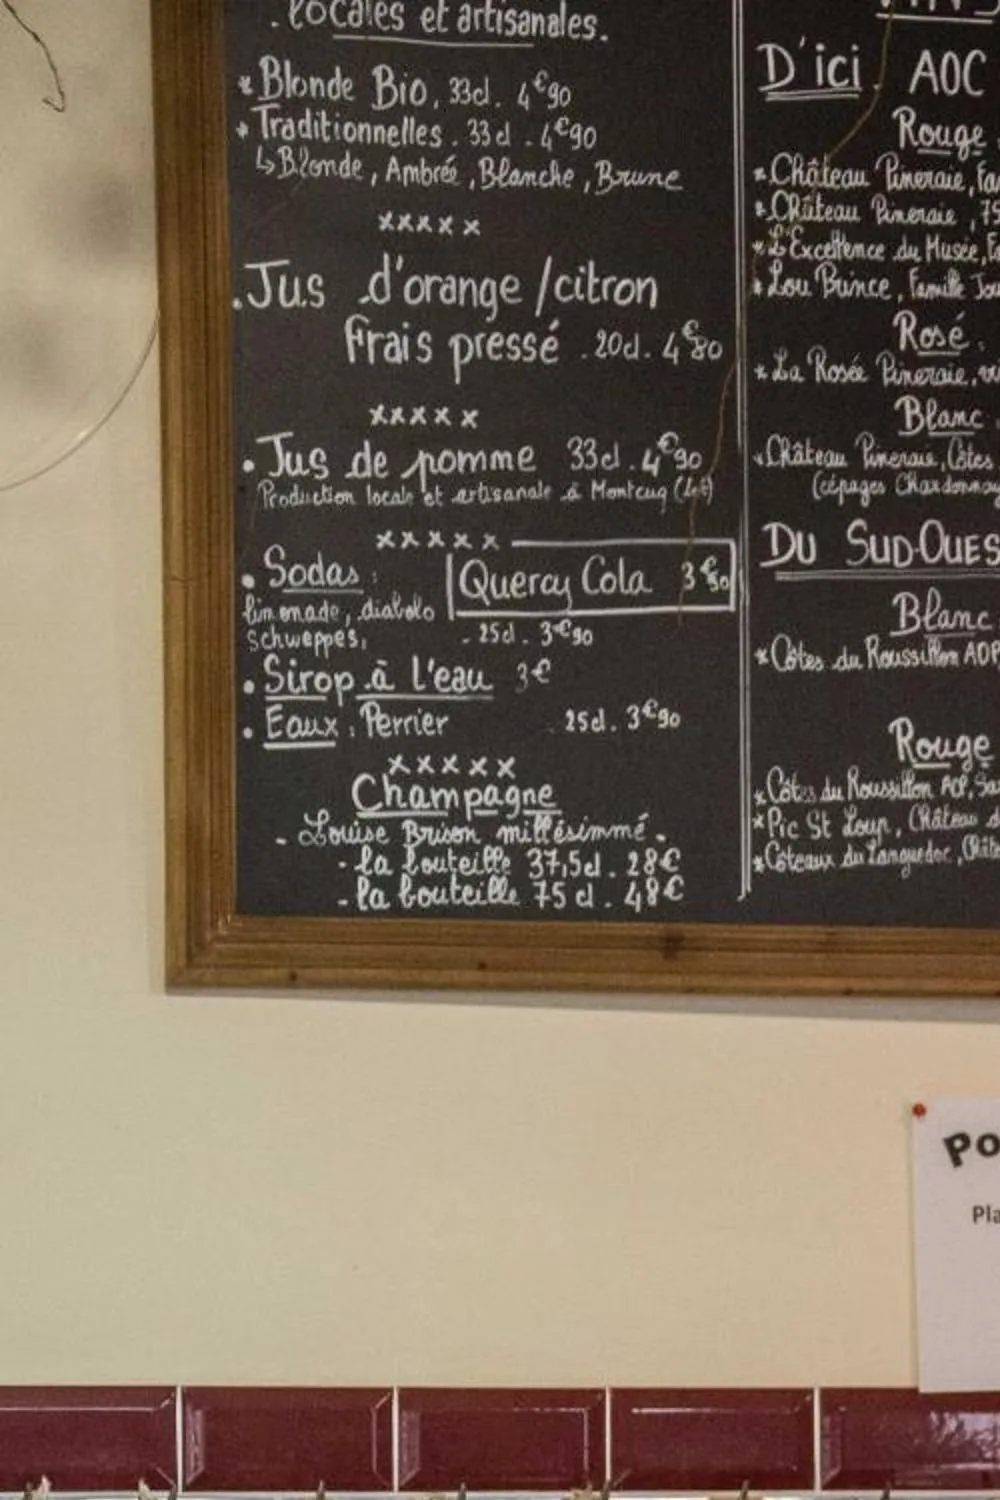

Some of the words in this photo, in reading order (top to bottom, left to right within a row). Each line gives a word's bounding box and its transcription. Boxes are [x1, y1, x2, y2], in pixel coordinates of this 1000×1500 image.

[420, 0, 448, 33] et
[258, 56, 355, 102] Blonde
[909, 50, 987, 97] AOC
[252, 104, 442, 147] Traditionnelles
[892, 106, 987, 159] Rouge
[595, 160, 684, 196] Brune
[892, 235, 921, 262] du
[246, 259, 326, 311] Jus
[893, 309, 970, 350] Rosé
[449, 319, 560, 385] pressé
[894, 395, 985, 436] Blanc
[256, 431, 329, 480] Jus
[345, 439, 388, 479] de
[400, 446, 536, 494] pomme
[257, 478, 357, 509] Production
[760, 520, 818, 567] DU
[264, 545, 360, 588] Sodas
[459, 560, 573, 613] Quercy
[581, 555, 653, 595] Cola
[890, 586, 993, 637] Blanc
[832, 646, 864, 672] du
[264, 656, 357, 706] Sirop
[264, 703, 338, 741] Eaux
[360, 704, 450, 739] Perrier
[888, 716, 995, 772] Rouge
[352, 773, 556, 821] Champagne
[820, 776, 845, 801] du
[298, 809, 390, 847] Louise
[767, 805, 800, 840] Pic
[806, 810, 832, 840] St
[355, 847, 393, 877] la
[356, 882, 392, 911] la
